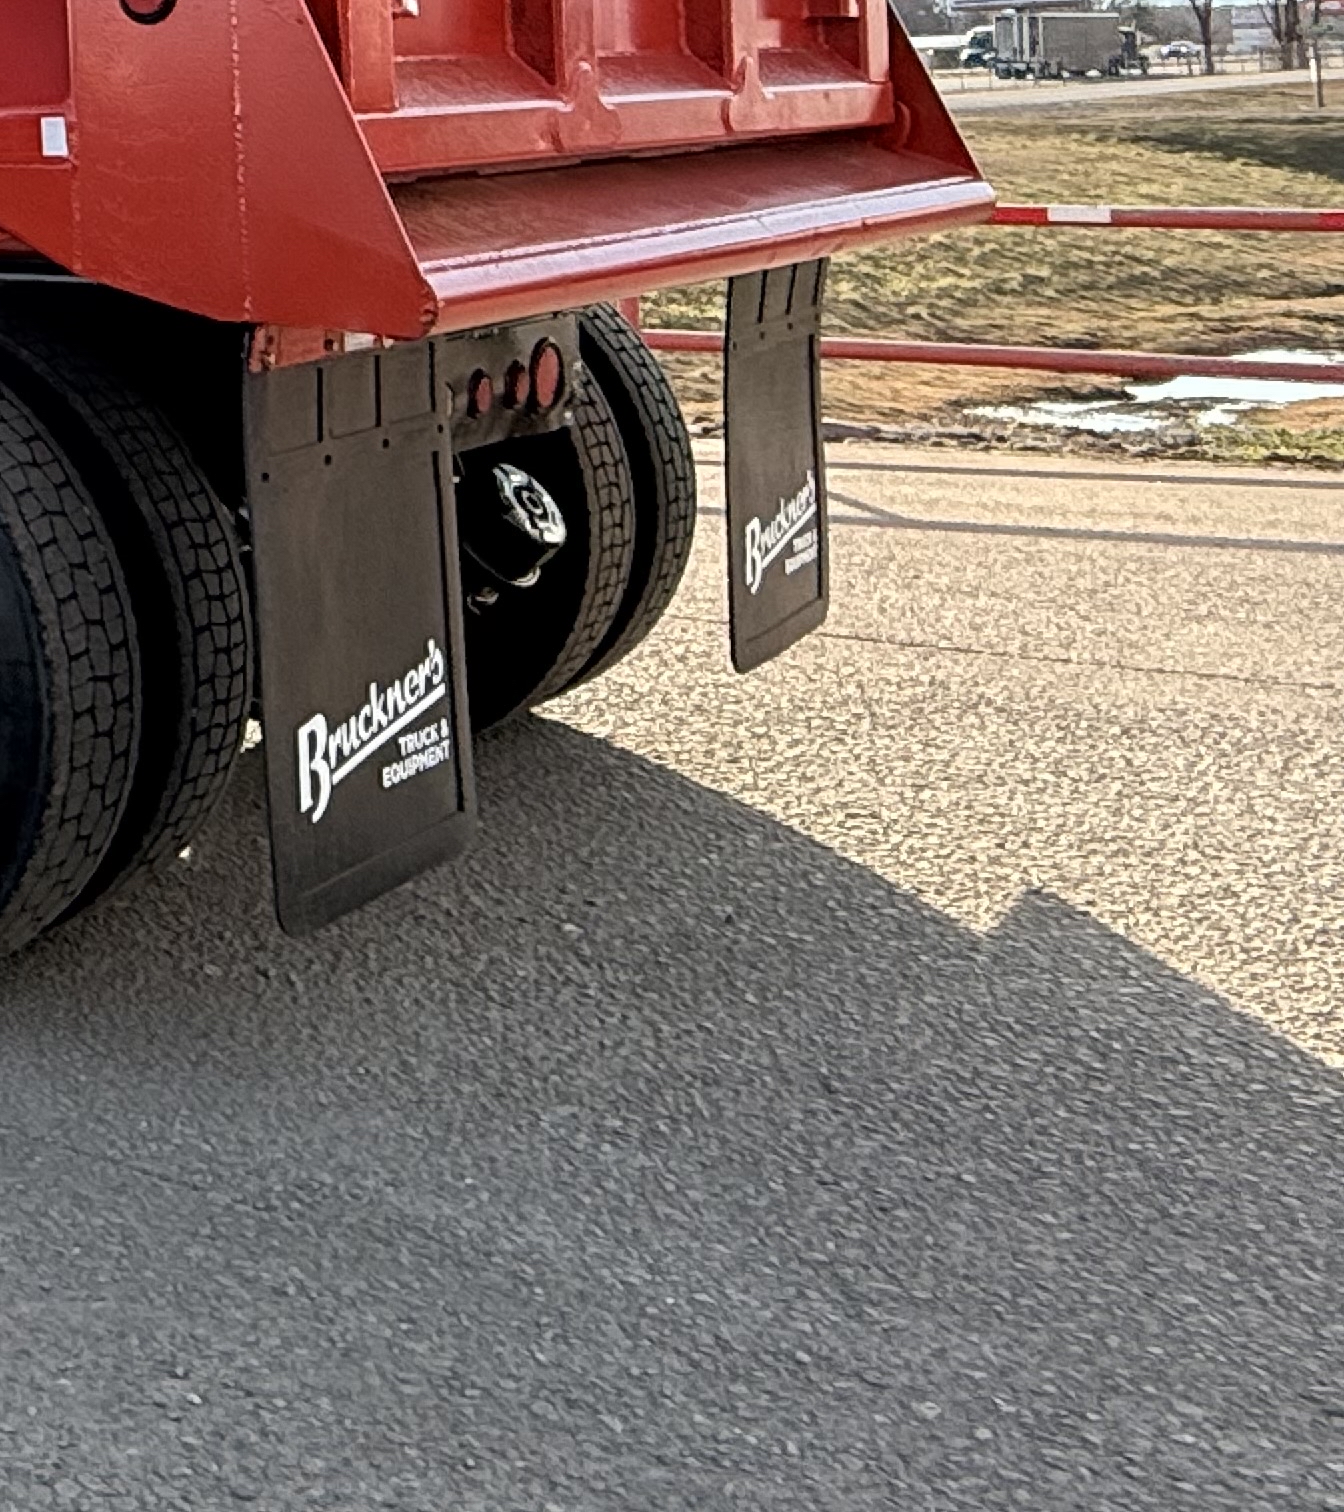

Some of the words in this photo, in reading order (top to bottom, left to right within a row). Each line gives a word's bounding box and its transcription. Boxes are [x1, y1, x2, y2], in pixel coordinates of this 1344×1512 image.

[297, 638, 445, 824] Bruckner's
[398, 723, 438, 756] TRUCK
[382, 738, 450, 788] EQUIPMENT
